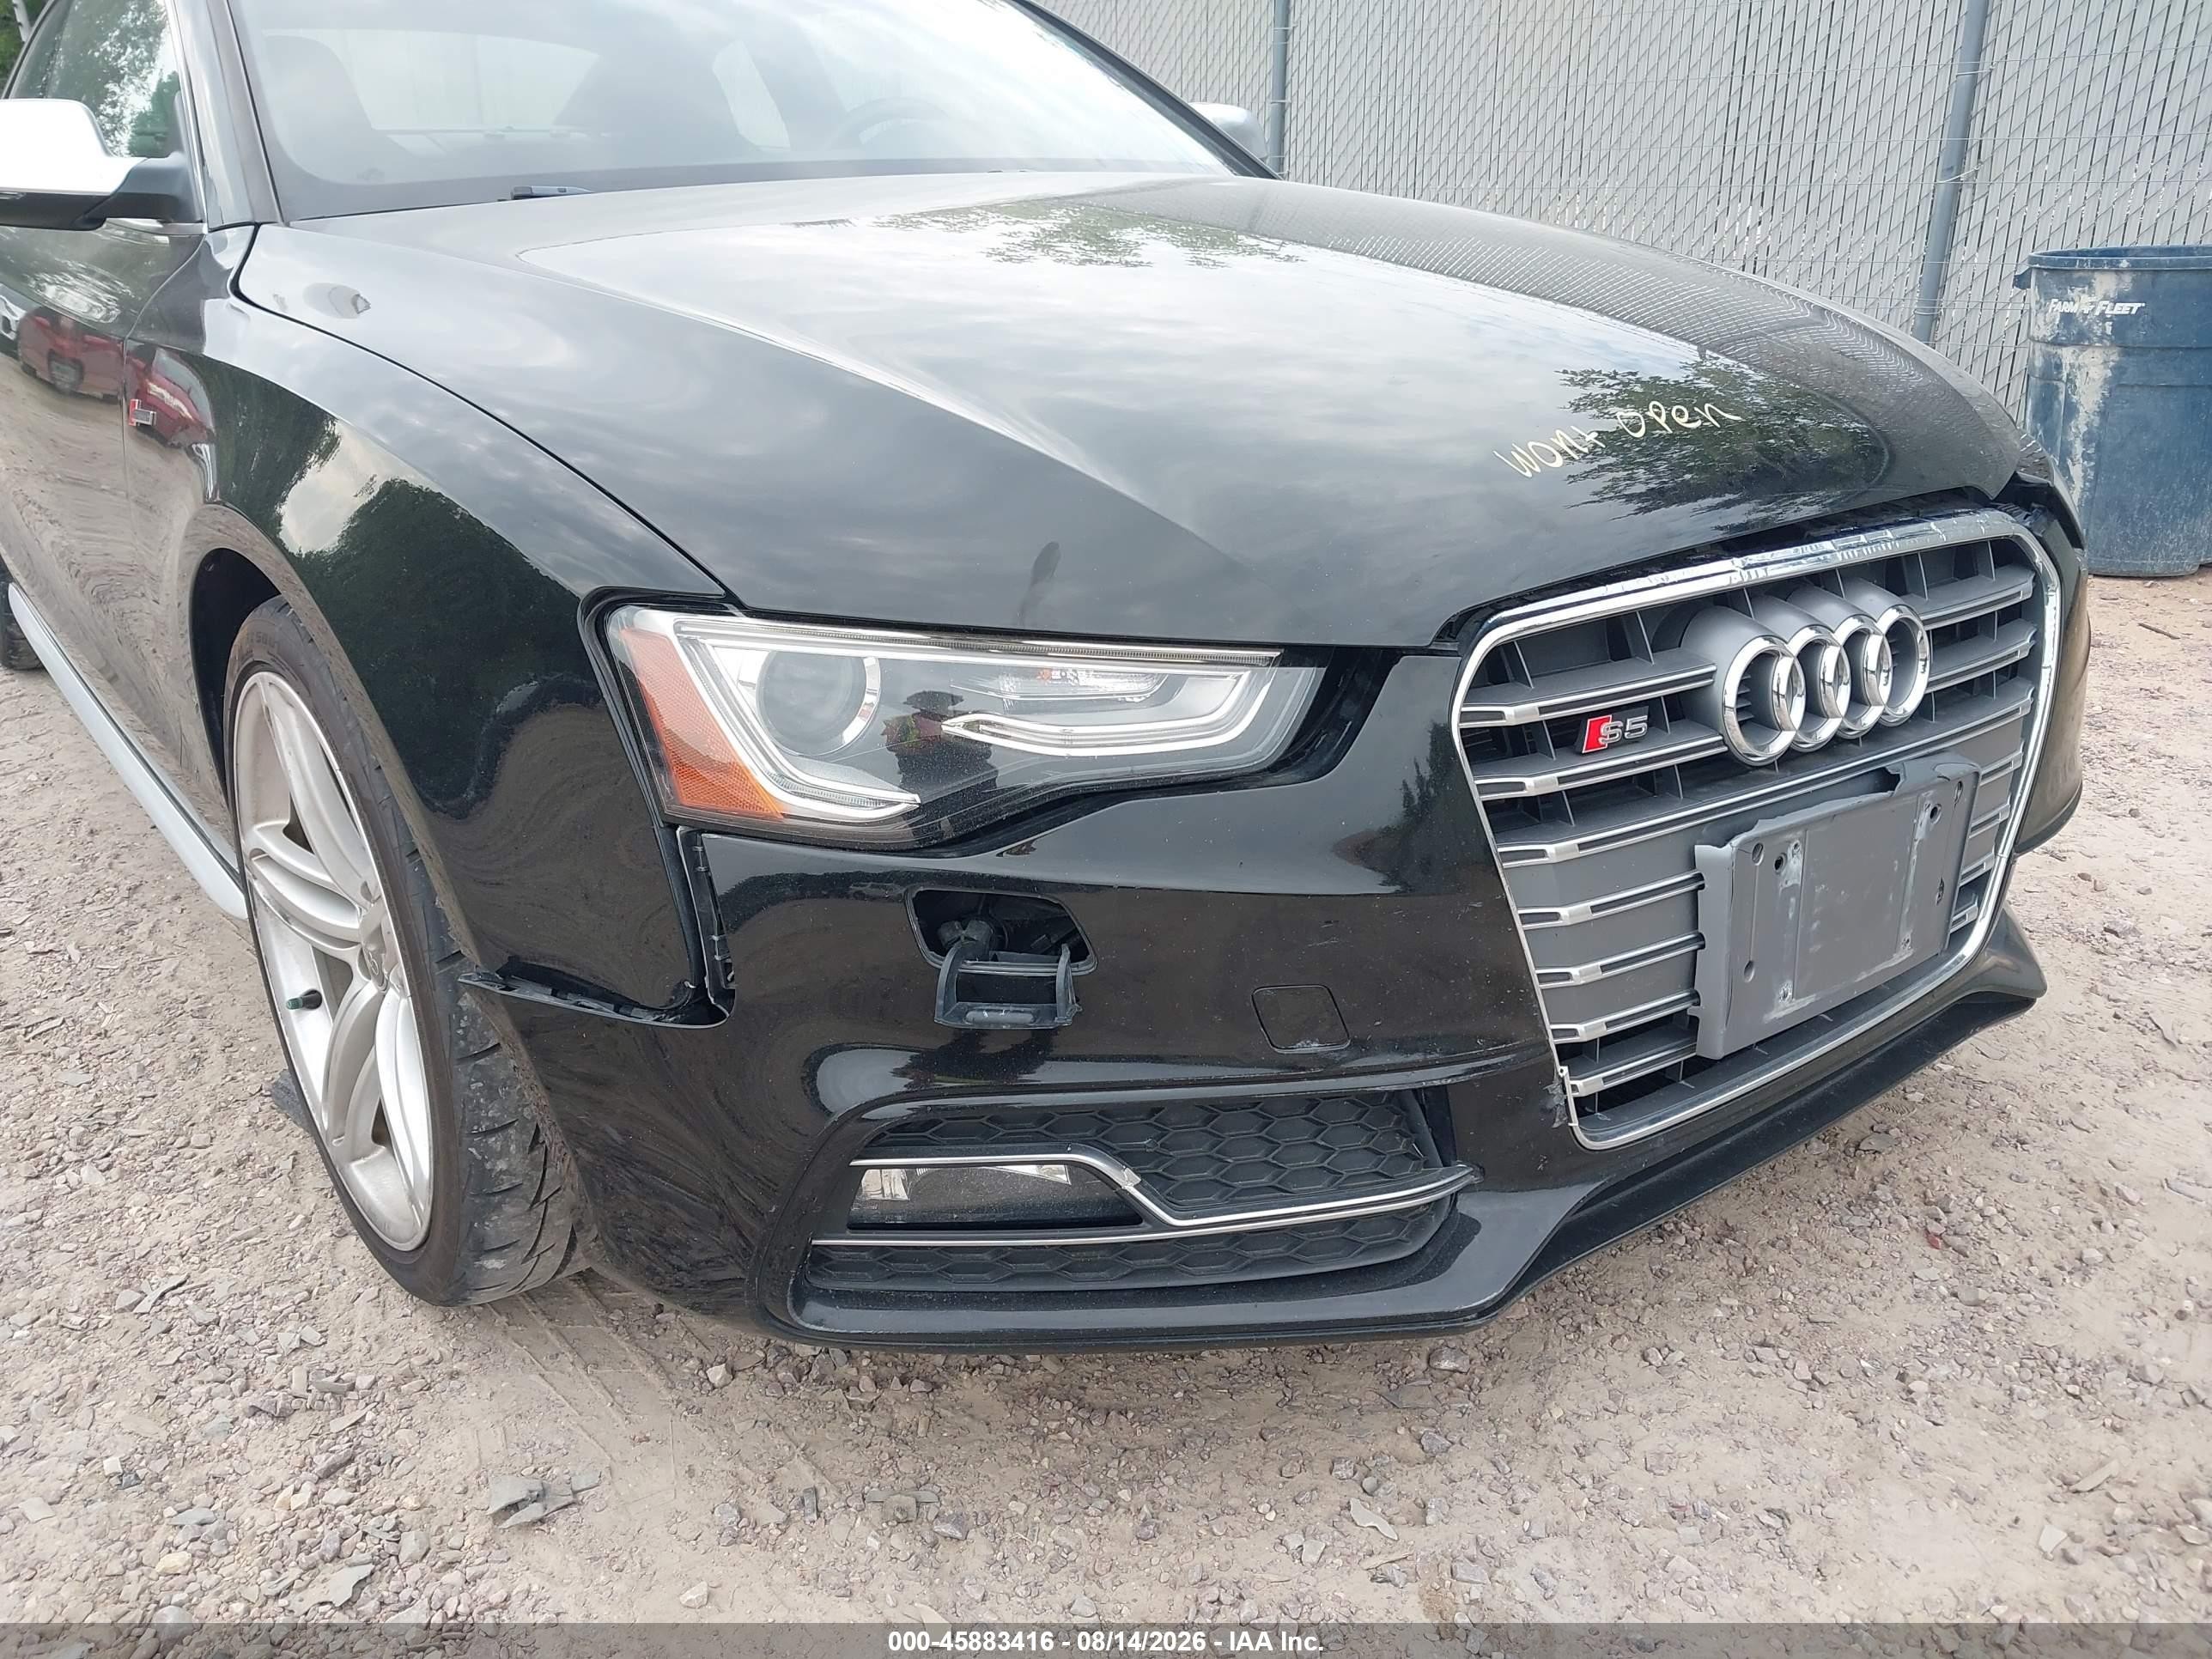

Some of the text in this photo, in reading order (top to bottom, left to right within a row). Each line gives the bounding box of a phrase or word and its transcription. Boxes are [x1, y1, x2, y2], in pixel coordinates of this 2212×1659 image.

[2047, 298, 2079, 313] FARM
[2094, 301, 2142, 316] FLEET
[1597, 714, 1649, 744] S5
